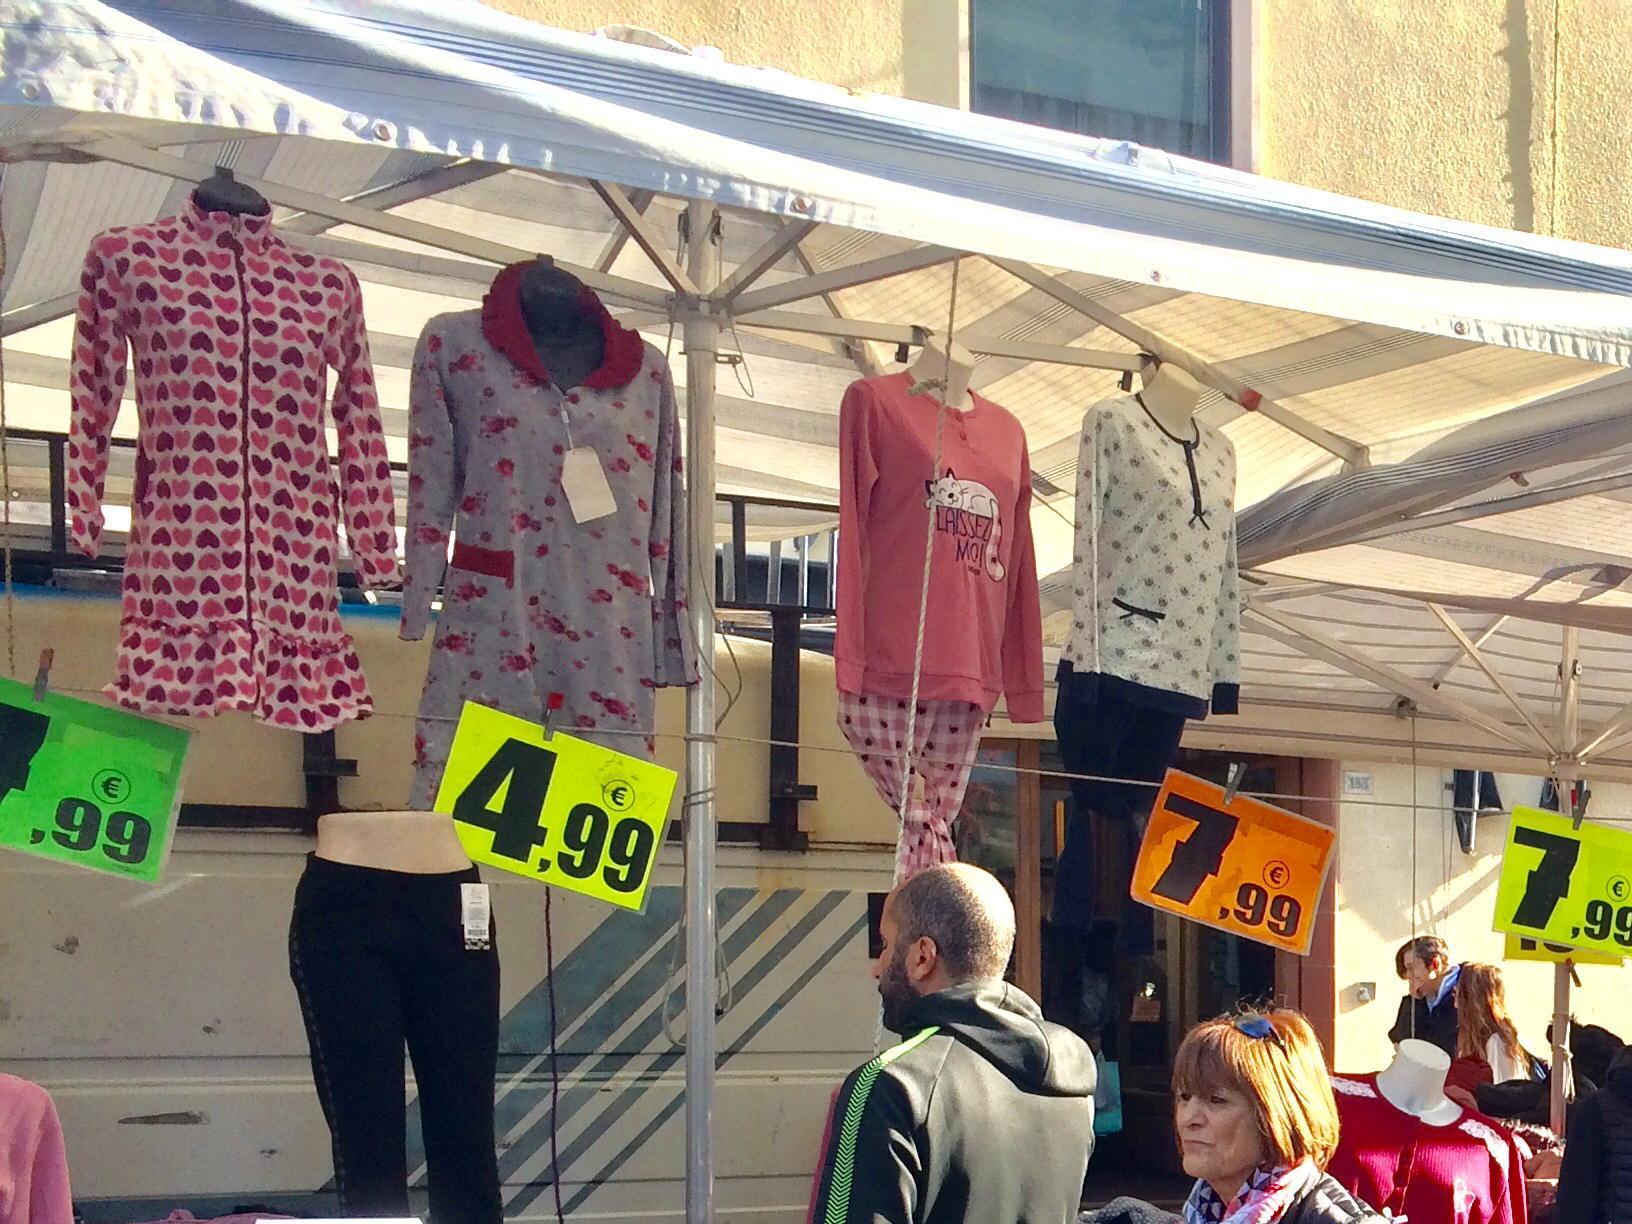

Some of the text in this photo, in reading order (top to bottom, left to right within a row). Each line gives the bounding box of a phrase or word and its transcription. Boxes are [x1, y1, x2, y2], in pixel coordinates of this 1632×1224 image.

[936, 505, 992, 541] LAISSEZ
[956, 539, 985, 568] MOI
[453, 737, 655, 893] 4,99
[1151, 792, 1302, 938] 7,99
